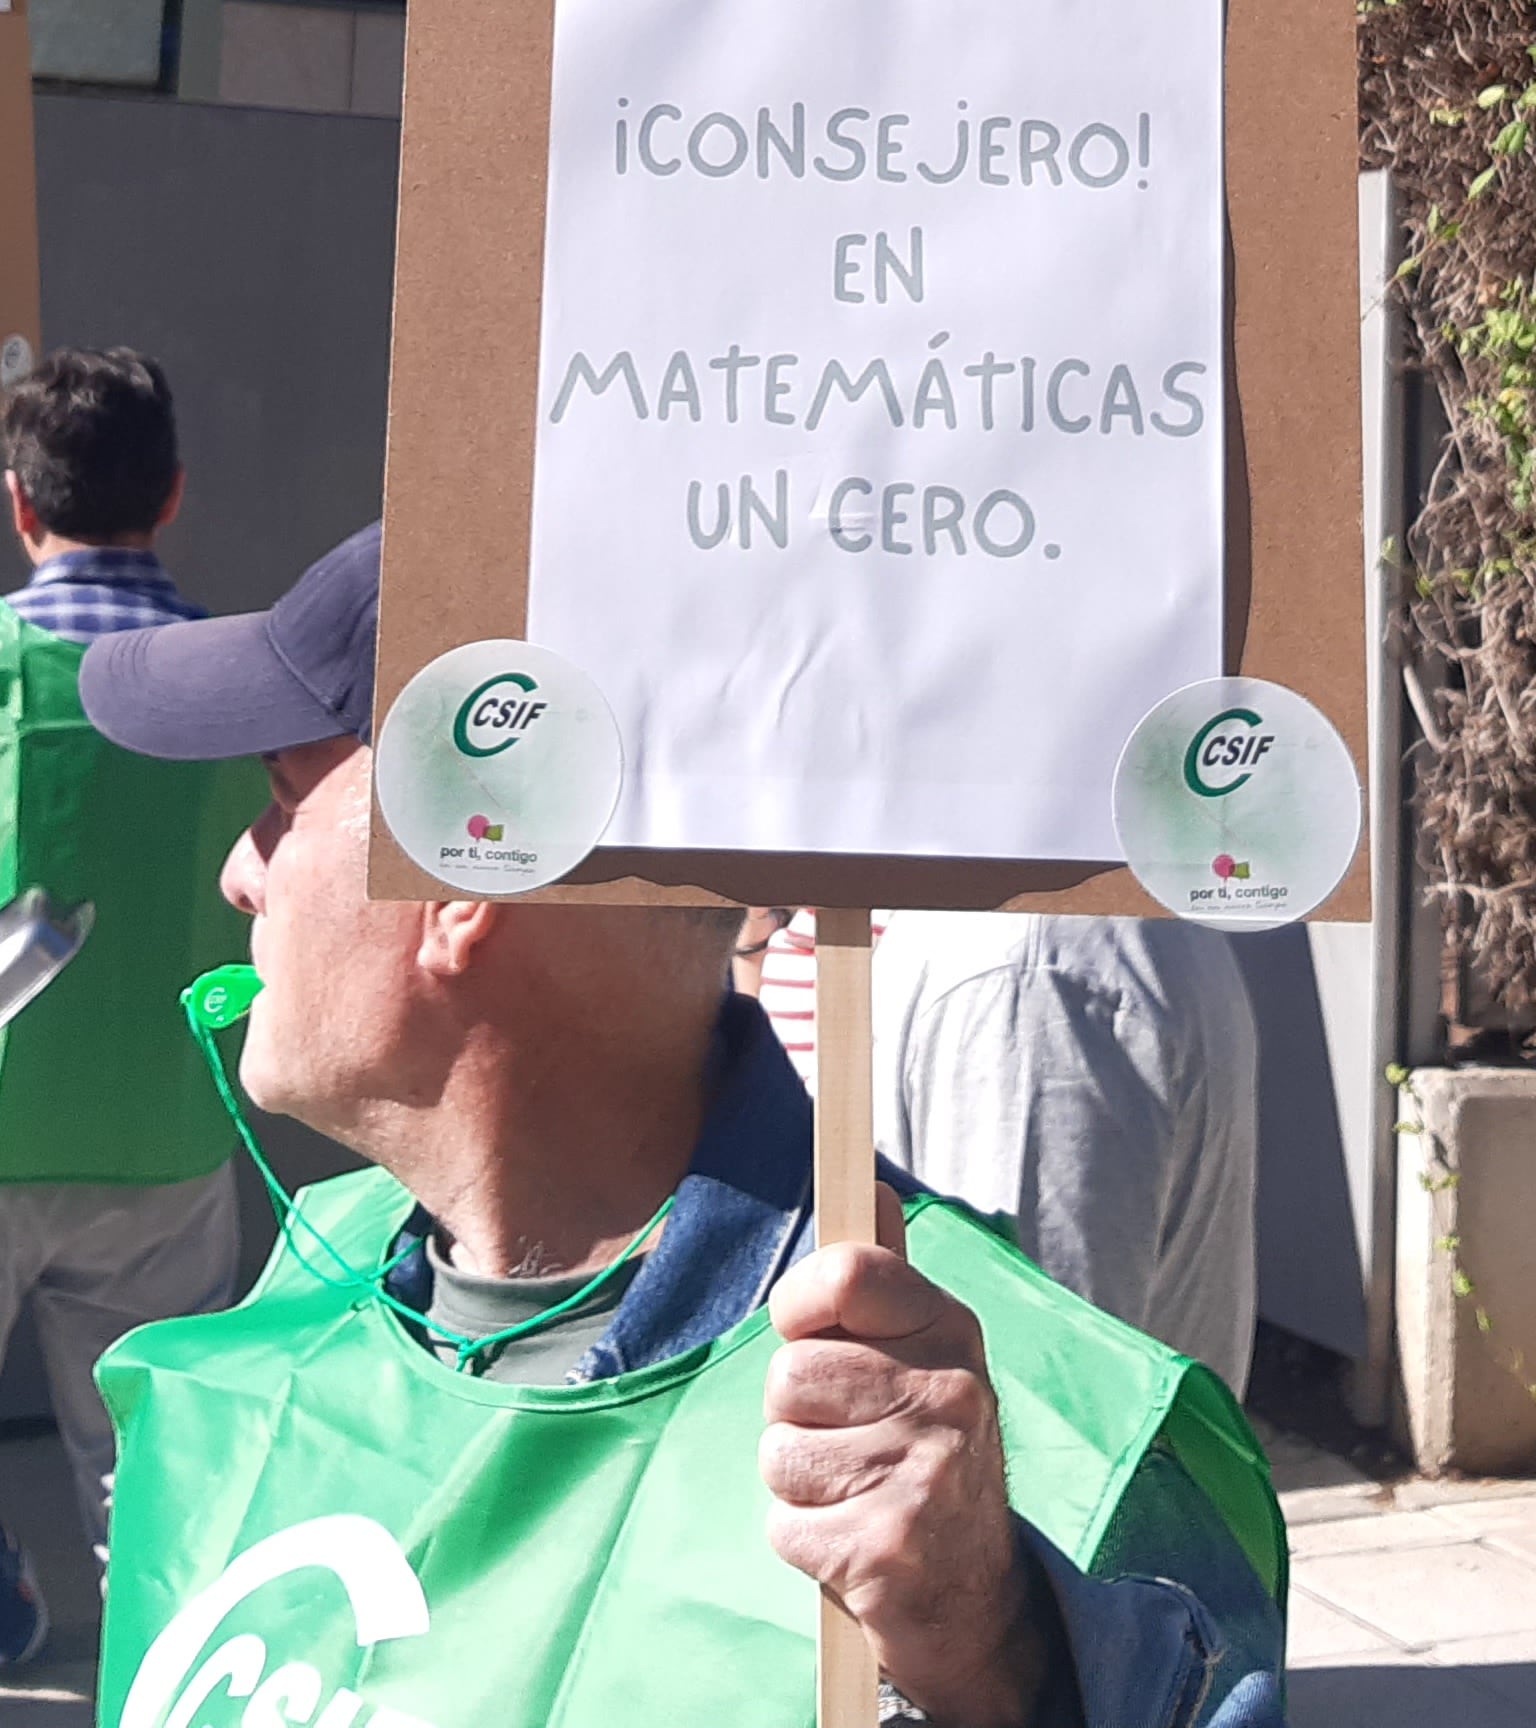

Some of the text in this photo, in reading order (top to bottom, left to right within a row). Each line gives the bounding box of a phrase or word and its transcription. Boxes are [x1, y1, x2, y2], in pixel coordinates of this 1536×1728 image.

[614, 98, 1152, 190] ¡CONSEJERO!
[831, 224, 925, 305] EN
[548, 329, 1207, 438] MATEMÁTICAS
[685, 468, 1063, 561] UN CERO.
[439, 846, 464, 859] por
[485, 848, 538, 864] contigo
[1190, 889, 1214, 902] por
[1235, 885, 1288, 900] contigo
